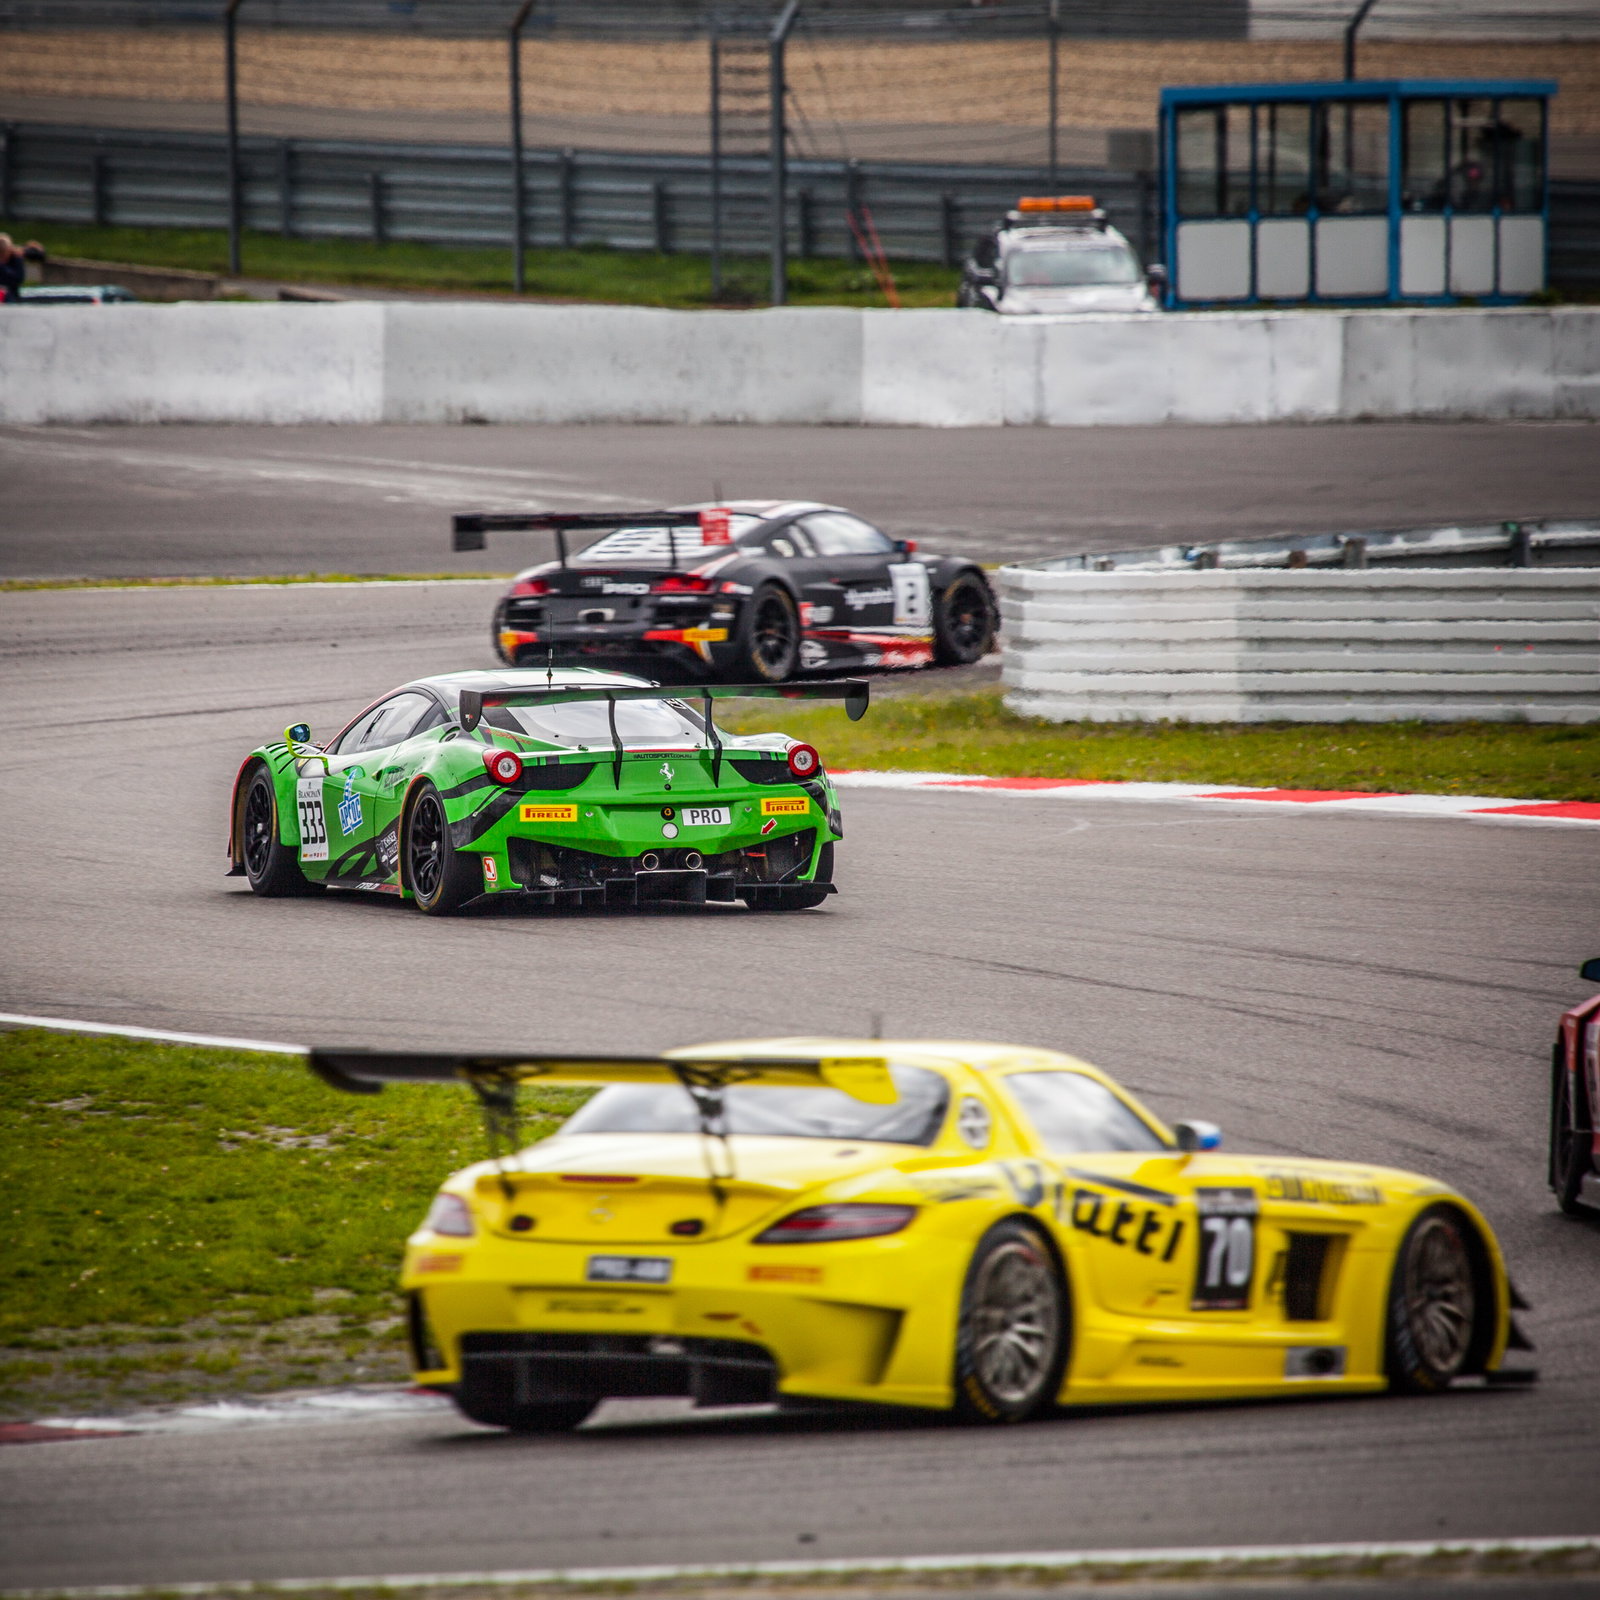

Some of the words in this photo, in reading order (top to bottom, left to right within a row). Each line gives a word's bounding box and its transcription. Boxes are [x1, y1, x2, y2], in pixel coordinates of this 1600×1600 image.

[525, 807, 571, 819] PIRELLI
[765, 800, 805, 812] PIRELLI
[298, 800, 326, 845] 333
[690, 808, 722, 824] PRO
[1203, 1217, 1252, 1288] 70
